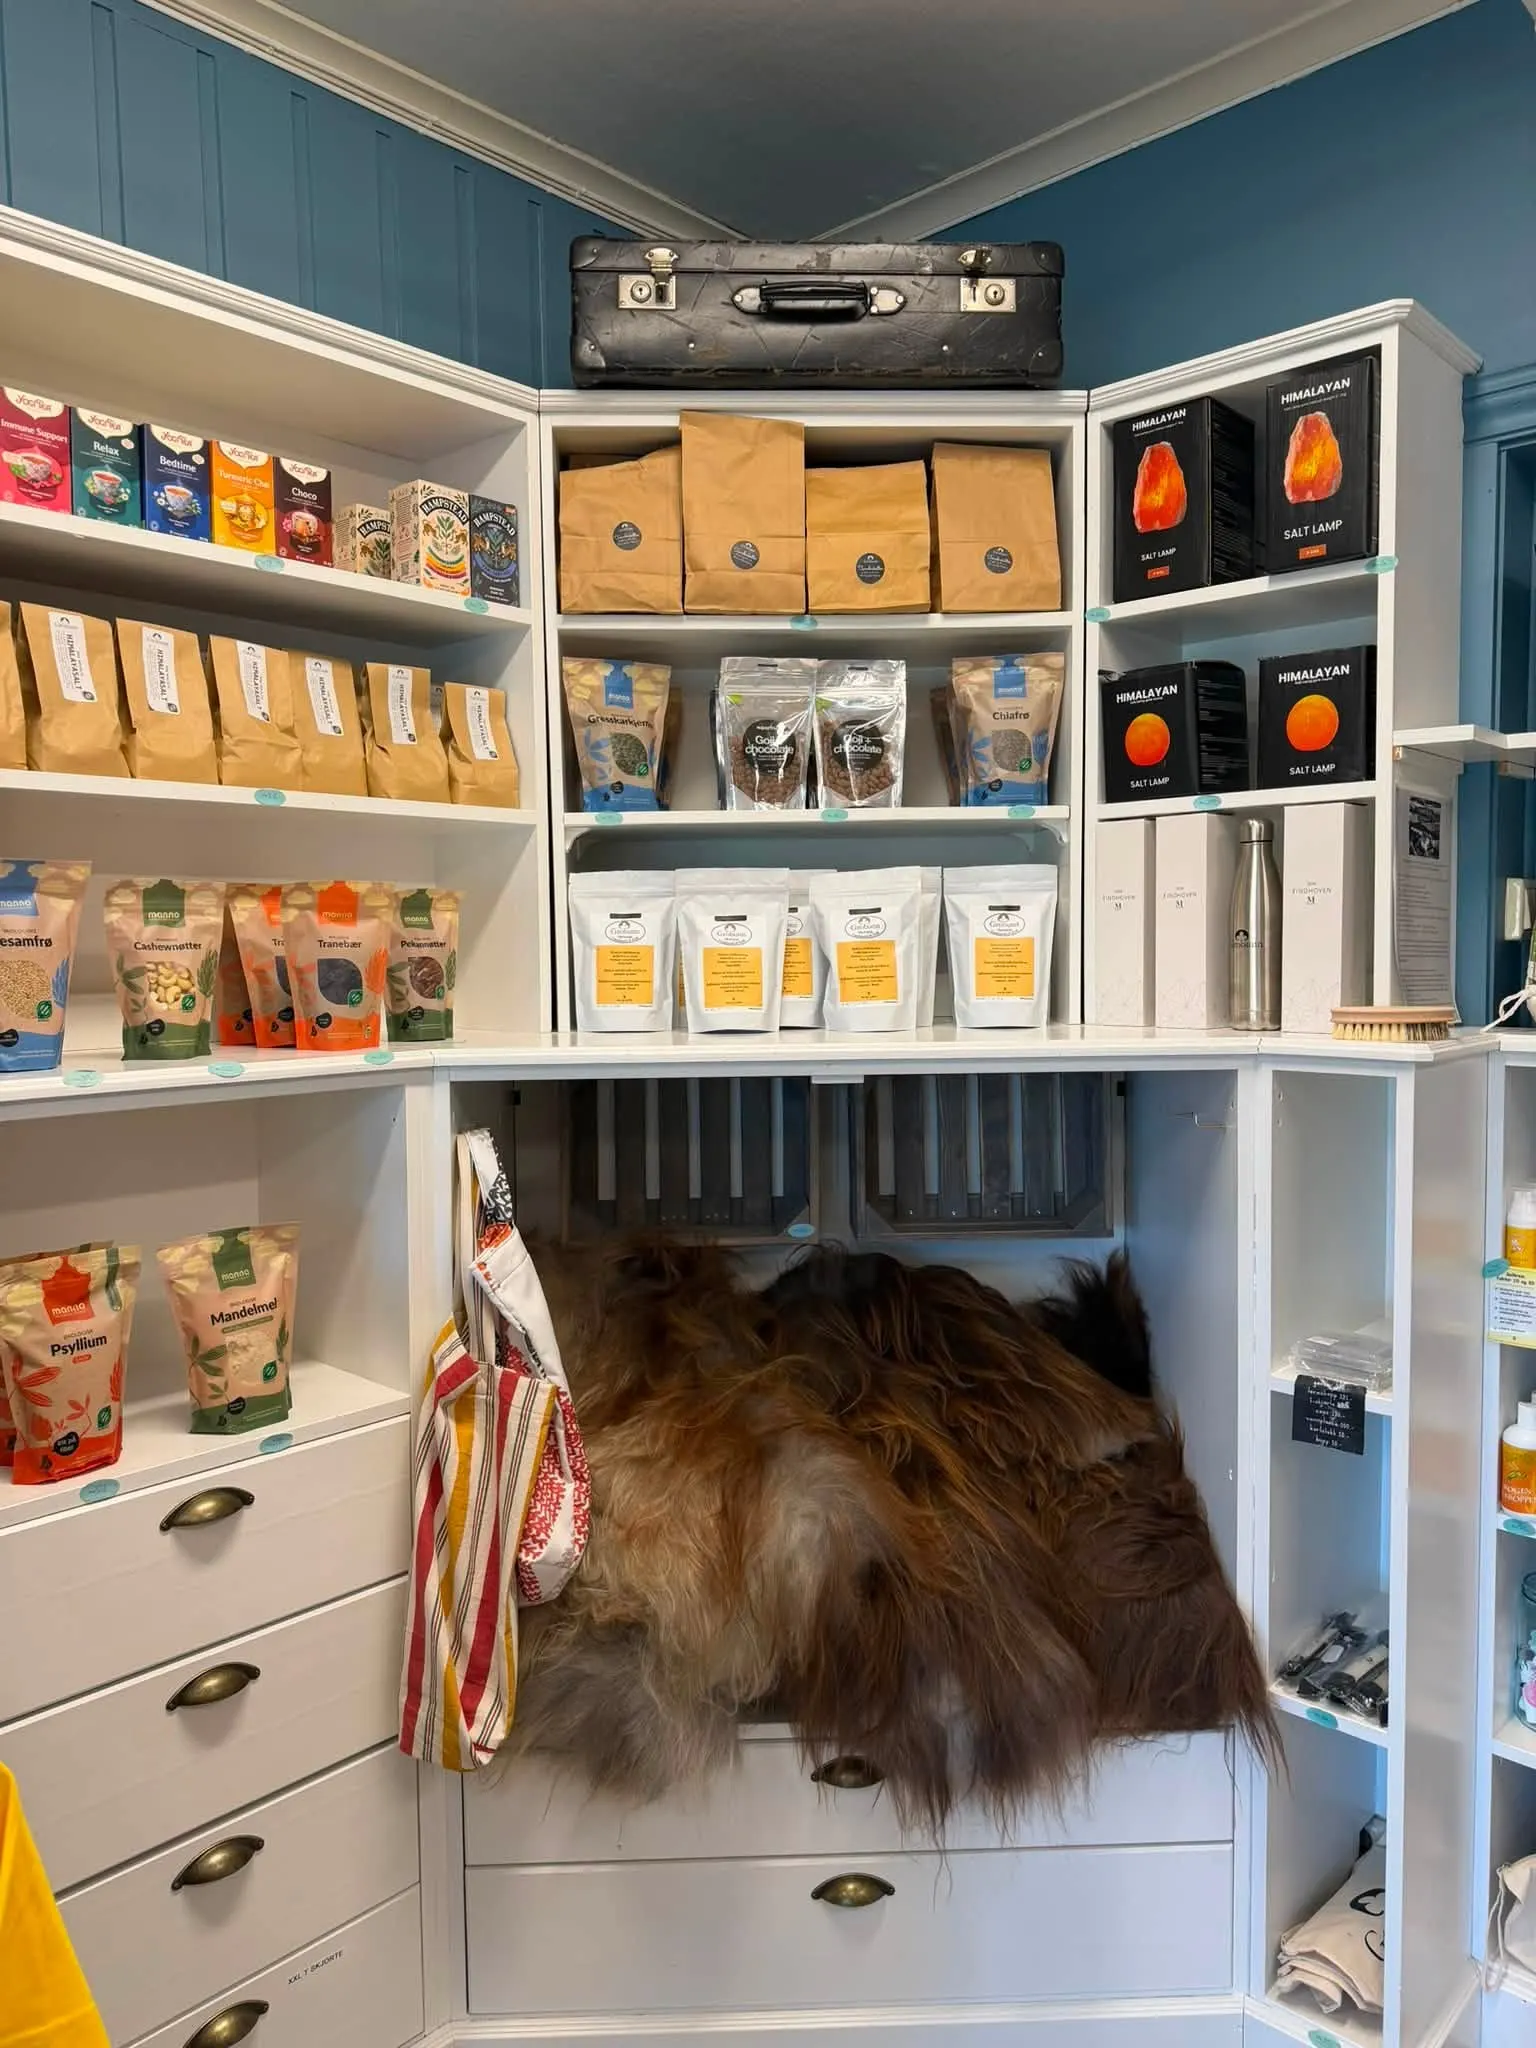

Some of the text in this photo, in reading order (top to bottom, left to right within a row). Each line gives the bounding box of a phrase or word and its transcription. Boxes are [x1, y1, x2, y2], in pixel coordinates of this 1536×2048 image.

[1281, 377, 1350, 404] HIMALAYAN
[1132, 408, 1187, 432] HIMALAYAN
[1, 418, 68, 444] Immune Support
[93, 440, 119, 456] Relax
[160, 455, 197, 473] Bedtime
[291, 487, 318, 501] Choco
[422, 498, 468, 523] HAMPSTEAD
[473, 511, 516, 536] HAMPSTEAD
[1283, 519, 1343, 540] SALT LAMP
[1141, 547, 1177, 562] SALT LAMP
[1278, 664, 1350, 685] HIMALAYAN
[1116, 684, 1178, 704] HIMALAYAN
[745, 744, 794, 754] chocolate
[1289, 763, 1336, 776] SALT LAMP
[1130, 776, 1170, 789] SALT LAMP
[0, 935, 53, 948] esamfrø
[134, 941, 203, 952] Cashewnøtter
[318, 939, 363, 949] Tranebær
[210, 1296, 278, 1327] Mandelmel
[50, 1335, 108, 1357] Psyllium
[288, 1974, 301, 1984] XXL
[310, 1951, 343, 1972] SKJORTE
